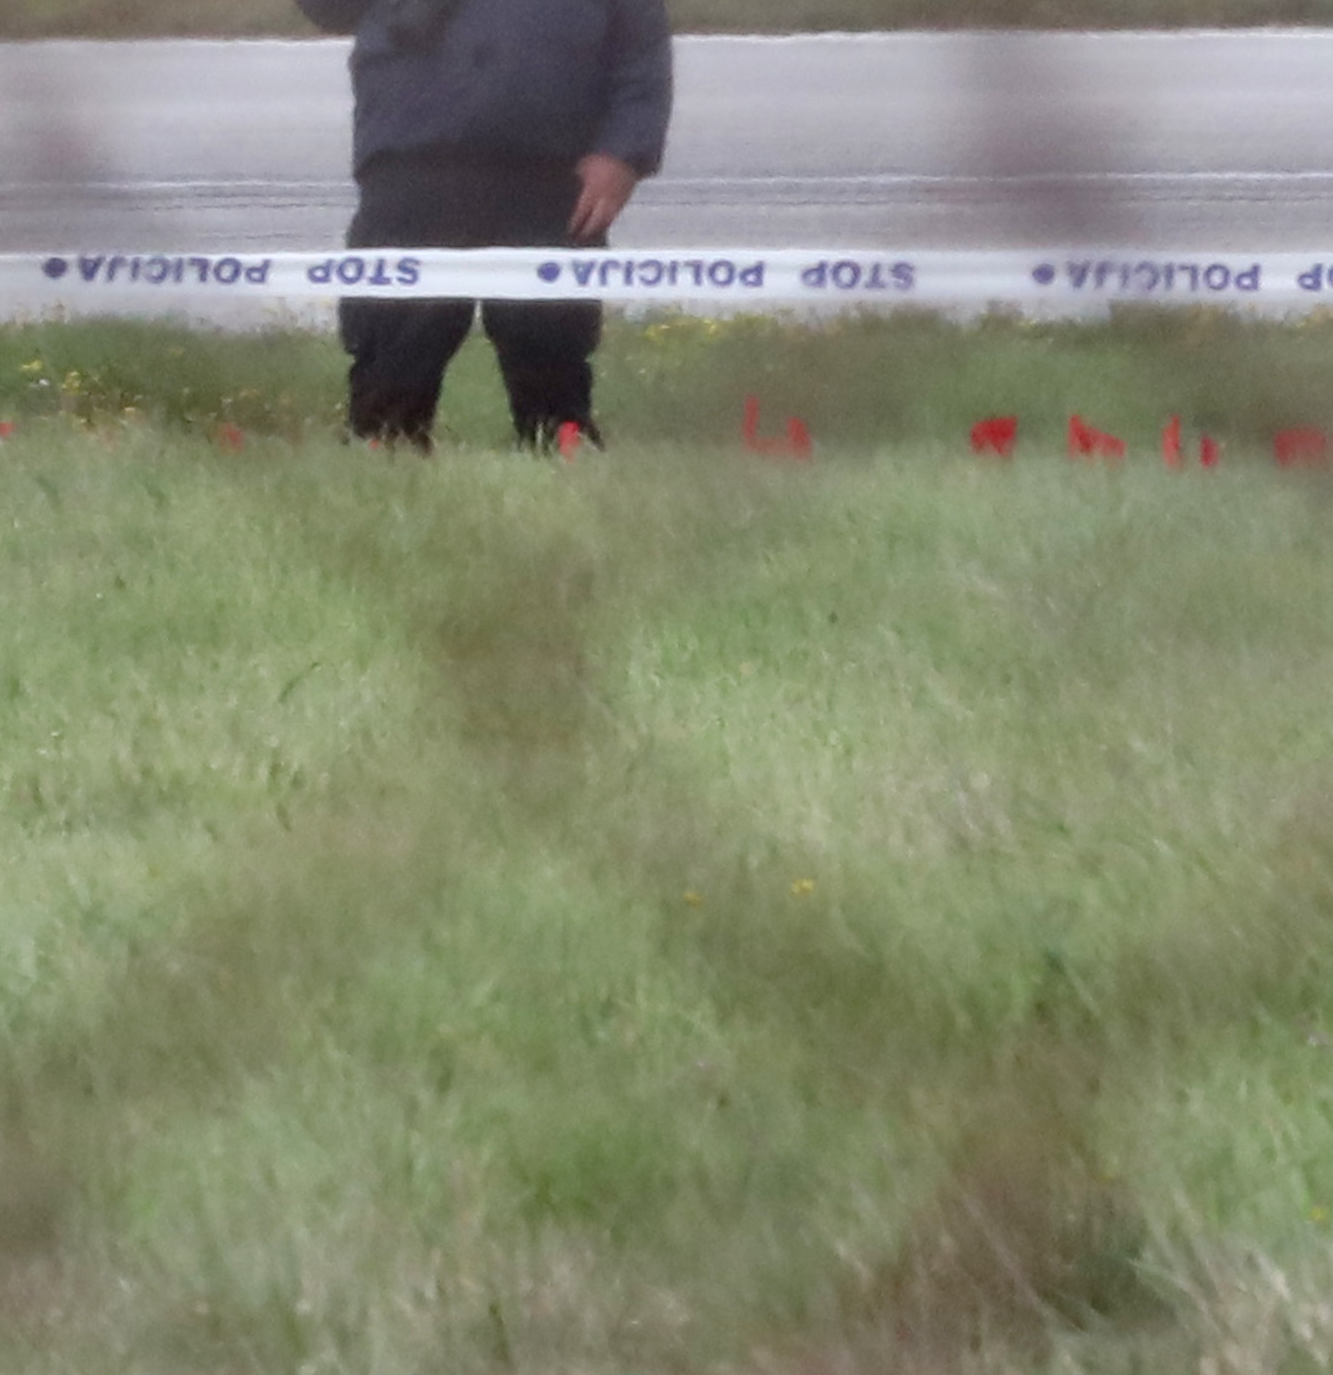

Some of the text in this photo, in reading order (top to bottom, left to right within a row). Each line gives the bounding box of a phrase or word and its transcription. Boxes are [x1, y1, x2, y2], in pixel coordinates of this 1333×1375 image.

[77, 255, 421, 286] STOP POLICIJA
[572, 259, 916, 290] STOP POLICIJA
[1066, 260, 1261, 291] POLICIJA
